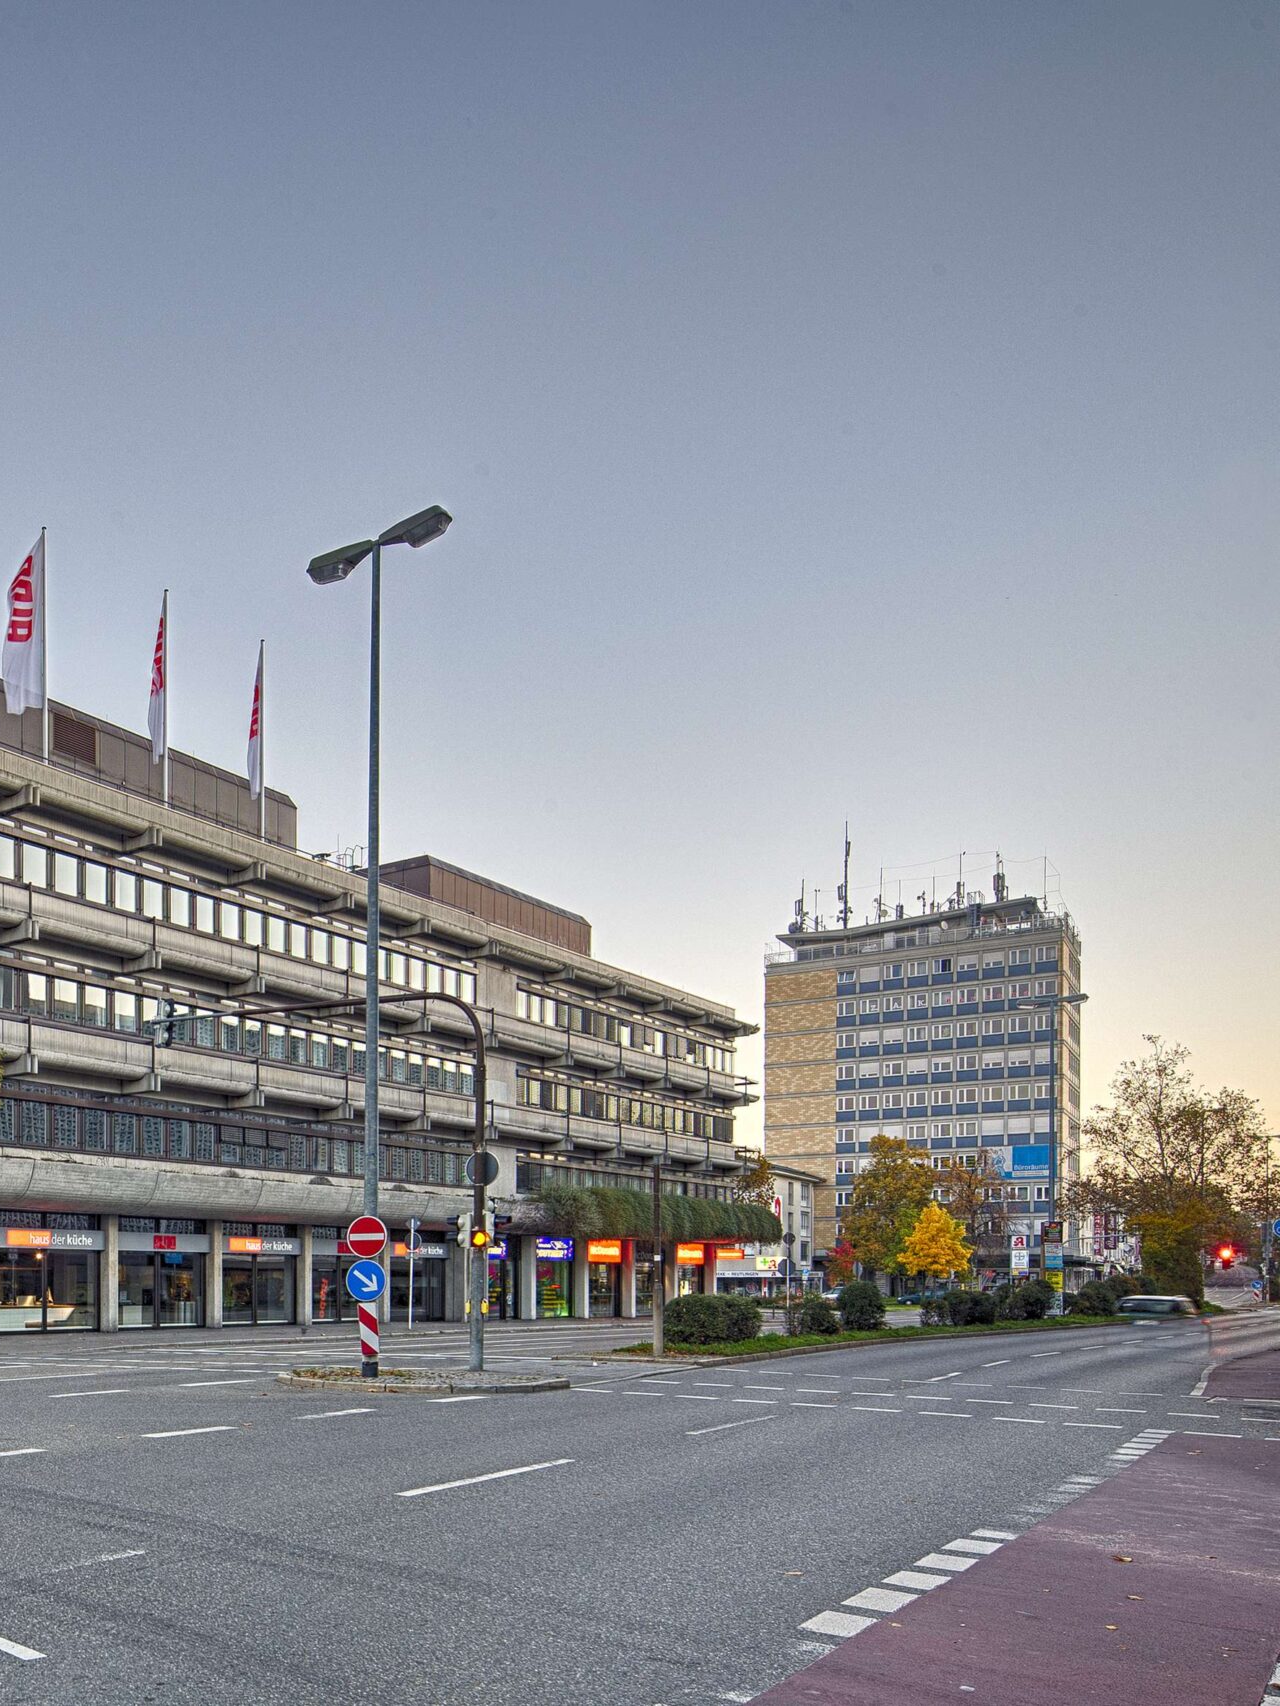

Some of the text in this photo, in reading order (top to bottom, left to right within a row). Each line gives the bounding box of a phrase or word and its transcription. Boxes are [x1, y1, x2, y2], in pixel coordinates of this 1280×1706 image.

[29, 1233, 93, 1245] haus der küche
[245, 1240, 293, 1251] haus der küche
[428, 1246, 444, 1255] küche
